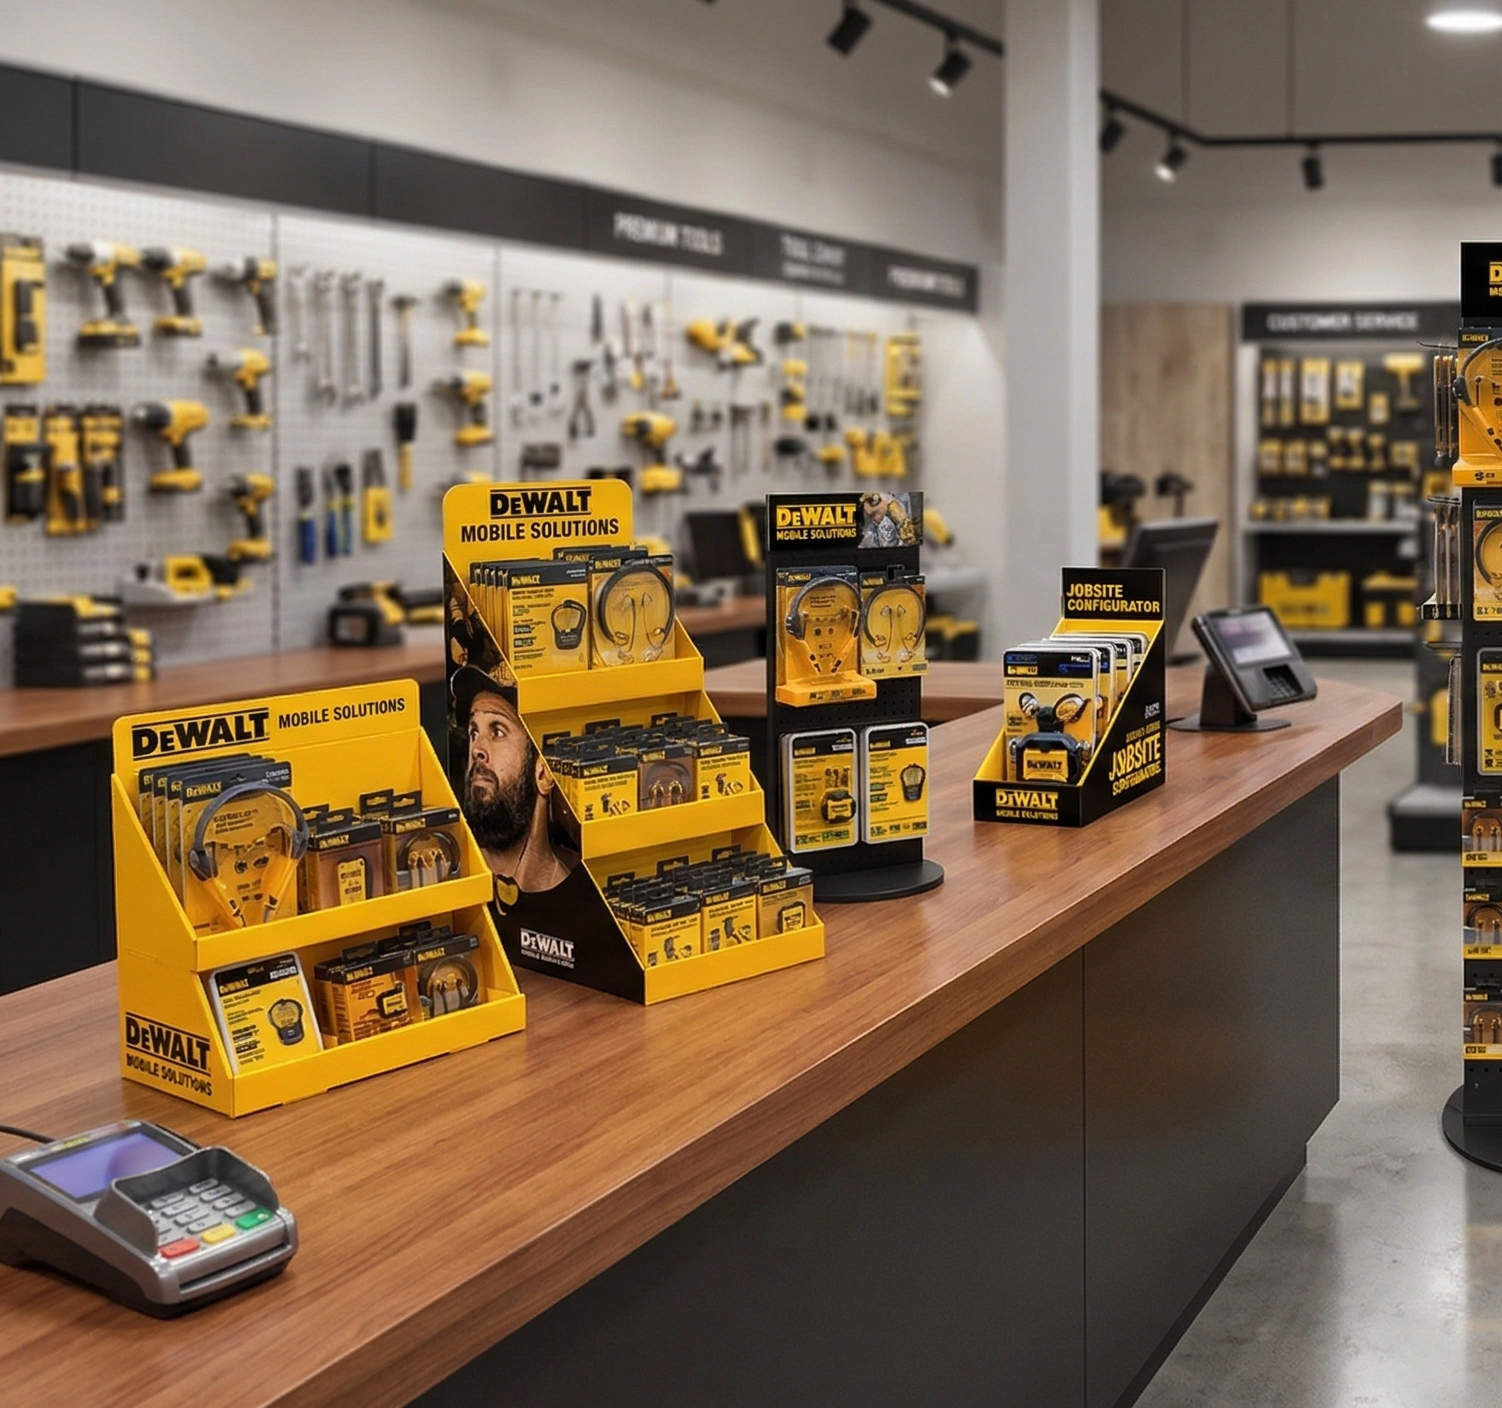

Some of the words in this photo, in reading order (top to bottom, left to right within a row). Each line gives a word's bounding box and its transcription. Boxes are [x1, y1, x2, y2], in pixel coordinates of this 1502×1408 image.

[1354, 311, 1418, 330] SERVICE
[490, 490, 592, 515] DEWALT
[776, 505, 857, 528] DEWALT
[461, 523, 525, 543] MOBILE
[530, 518, 619, 538] SOLUTIONS
[1066, 583, 1123, 599] JOBSITE
[1067, 599, 1160, 613] CONFIGURATOR
[278, 707, 330, 729] MOBILE
[333, 697, 406, 721] SOLUTIONS
[132, 711, 269, 757] DEWALT
[125, 1015, 211, 1071] DEWALT
